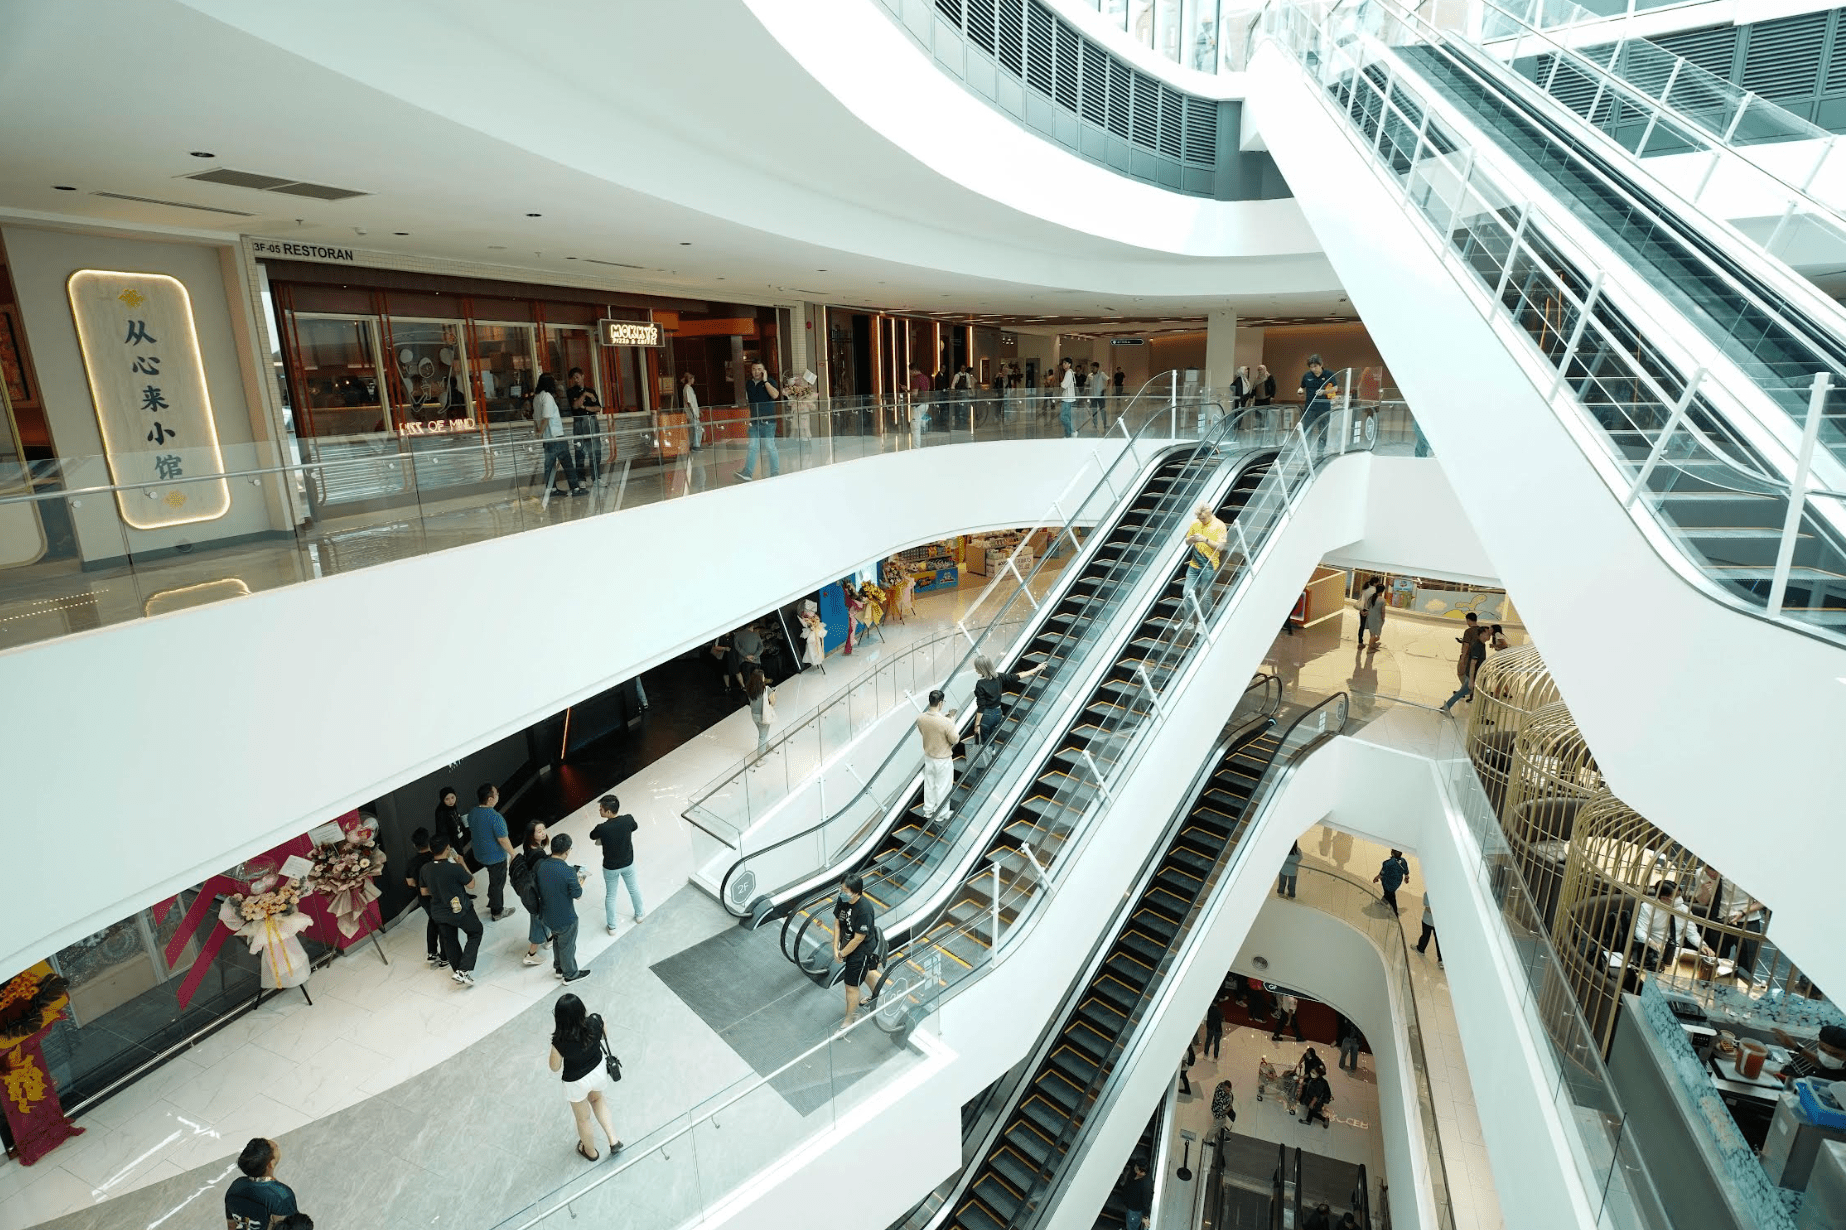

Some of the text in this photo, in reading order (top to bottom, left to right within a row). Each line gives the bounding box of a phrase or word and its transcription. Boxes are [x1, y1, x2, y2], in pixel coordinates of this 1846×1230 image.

[254, 242, 353, 260] 3F-05 RESTORAN
[124, 319, 183, 480] 从心来小馆
[737, 881, 749, 895] 2F
